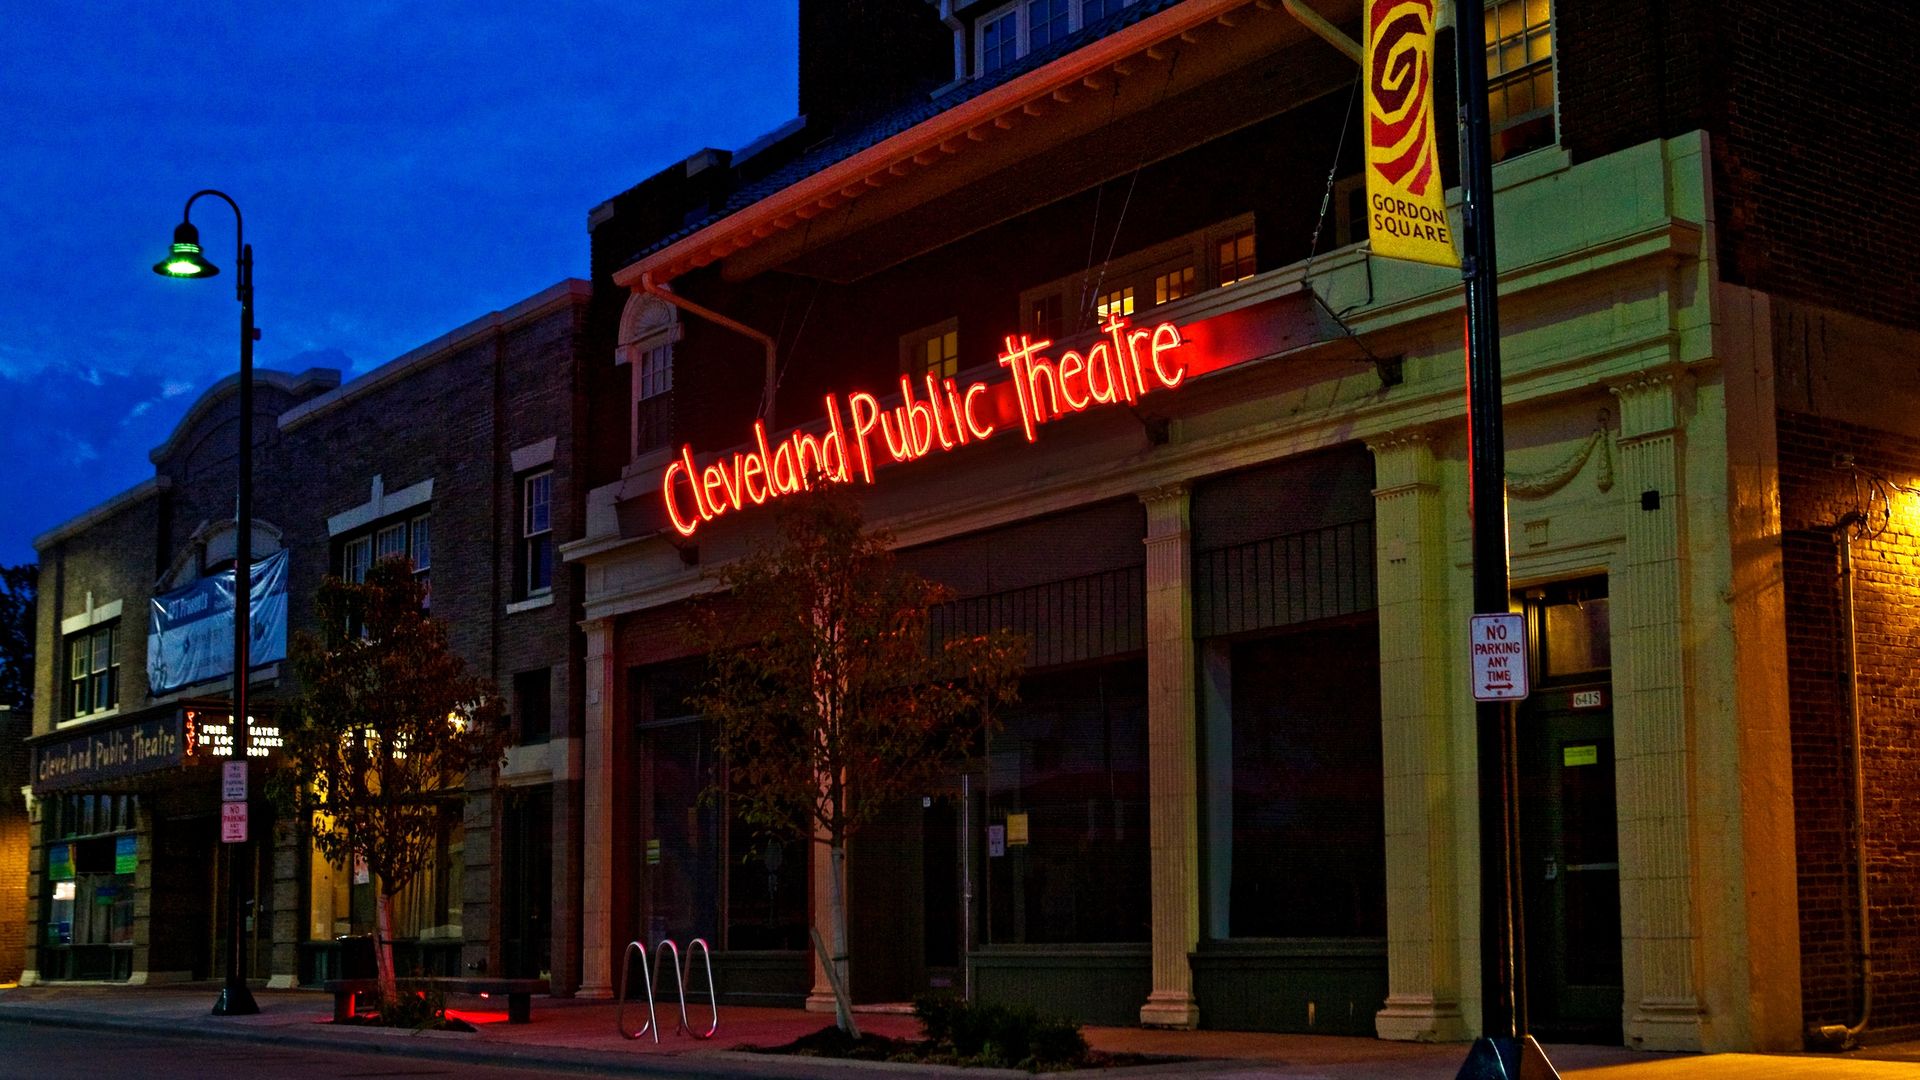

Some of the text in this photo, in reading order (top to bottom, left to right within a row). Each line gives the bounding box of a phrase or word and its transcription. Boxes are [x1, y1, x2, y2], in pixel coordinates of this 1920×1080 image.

[1372, 193, 1445, 225] GORDON
[1374, 213, 1450, 244] SQUARE
[663, 313, 1187, 537] Cleveland Public Theatre
[1486, 624, 1507, 641] NO
[1474, 641, 1521, 656] PARKING
[1487, 656, 1509, 669] ANY
[1486, 670, 1511, 682] TIME
[1575, 692, 1600, 706] 6415
[203, 724, 279, 737] FREE EATRE
[253, 736, 284, 747] PARKS
[39, 724, 176, 781] Cleveland Public Theatre
[229, 806, 240, 815] NO
